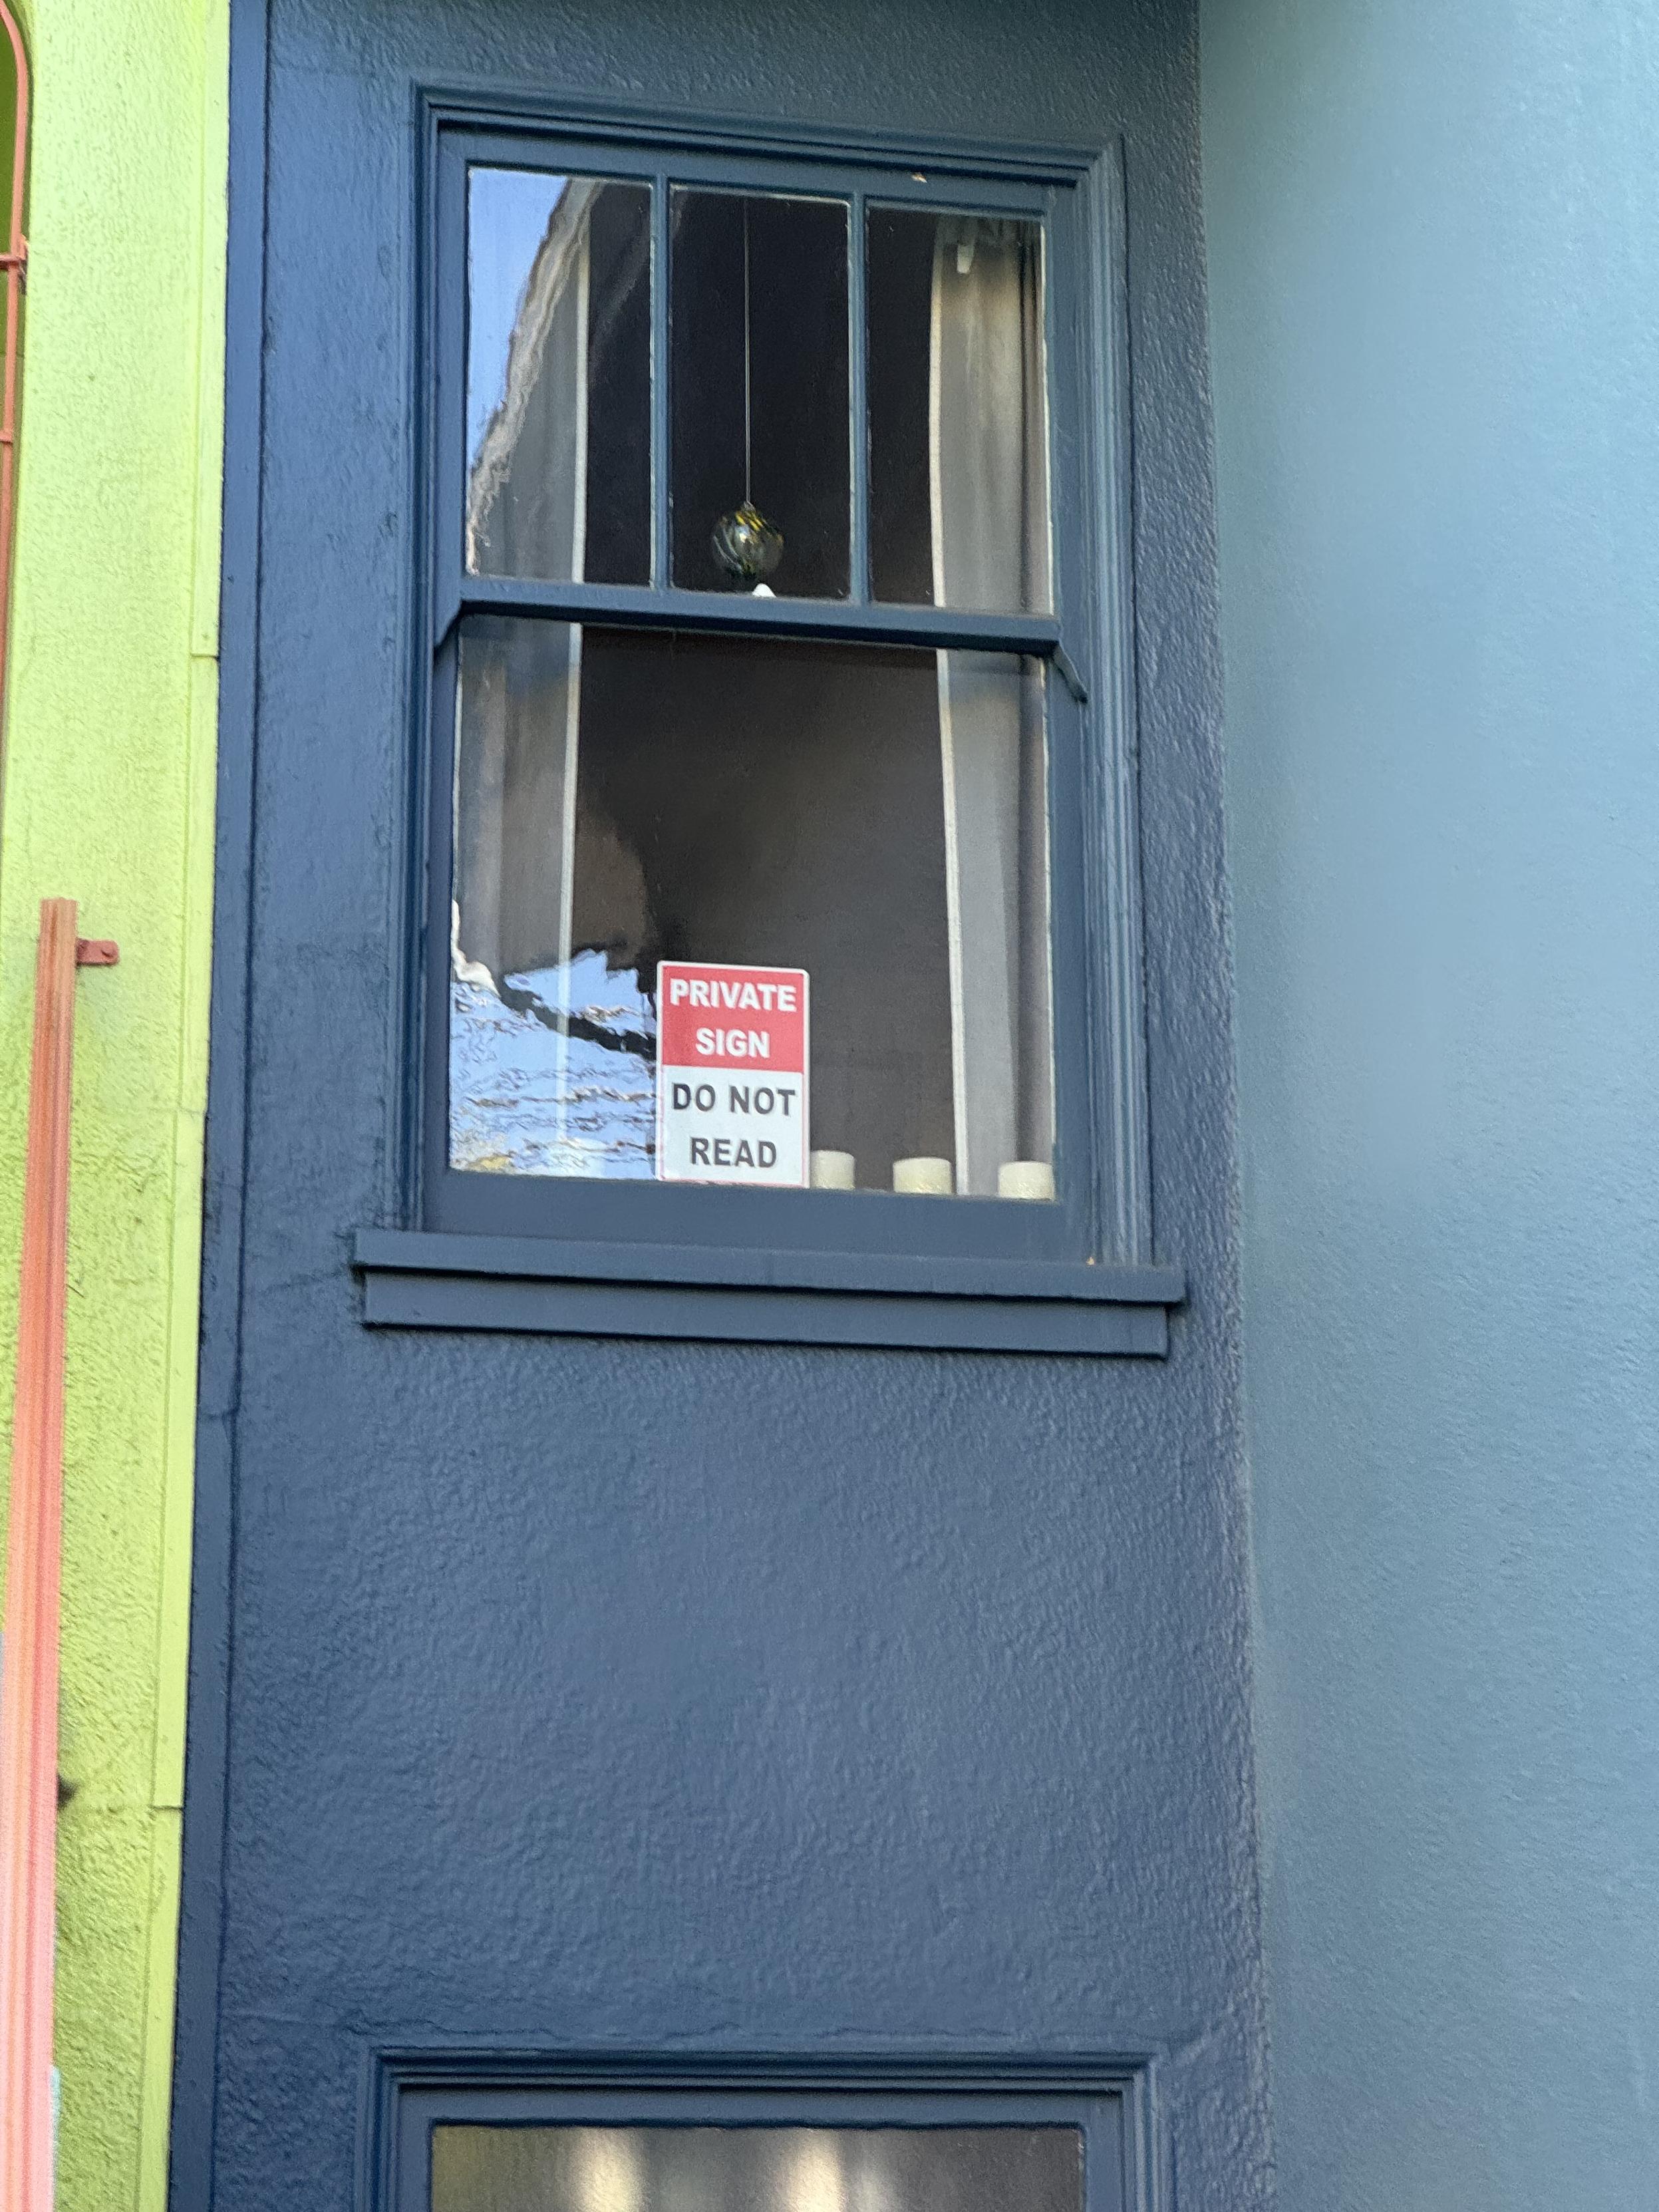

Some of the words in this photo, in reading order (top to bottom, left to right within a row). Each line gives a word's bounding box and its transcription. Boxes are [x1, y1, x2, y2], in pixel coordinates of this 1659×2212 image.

[670, 978, 797, 1012] PRIVATE
[695, 1028, 770, 1058] SIGN
[672, 1082, 715, 1112] DO
[730, 1085, 796, 1116] NOT
[690, 1136, 776, 1168] READ
